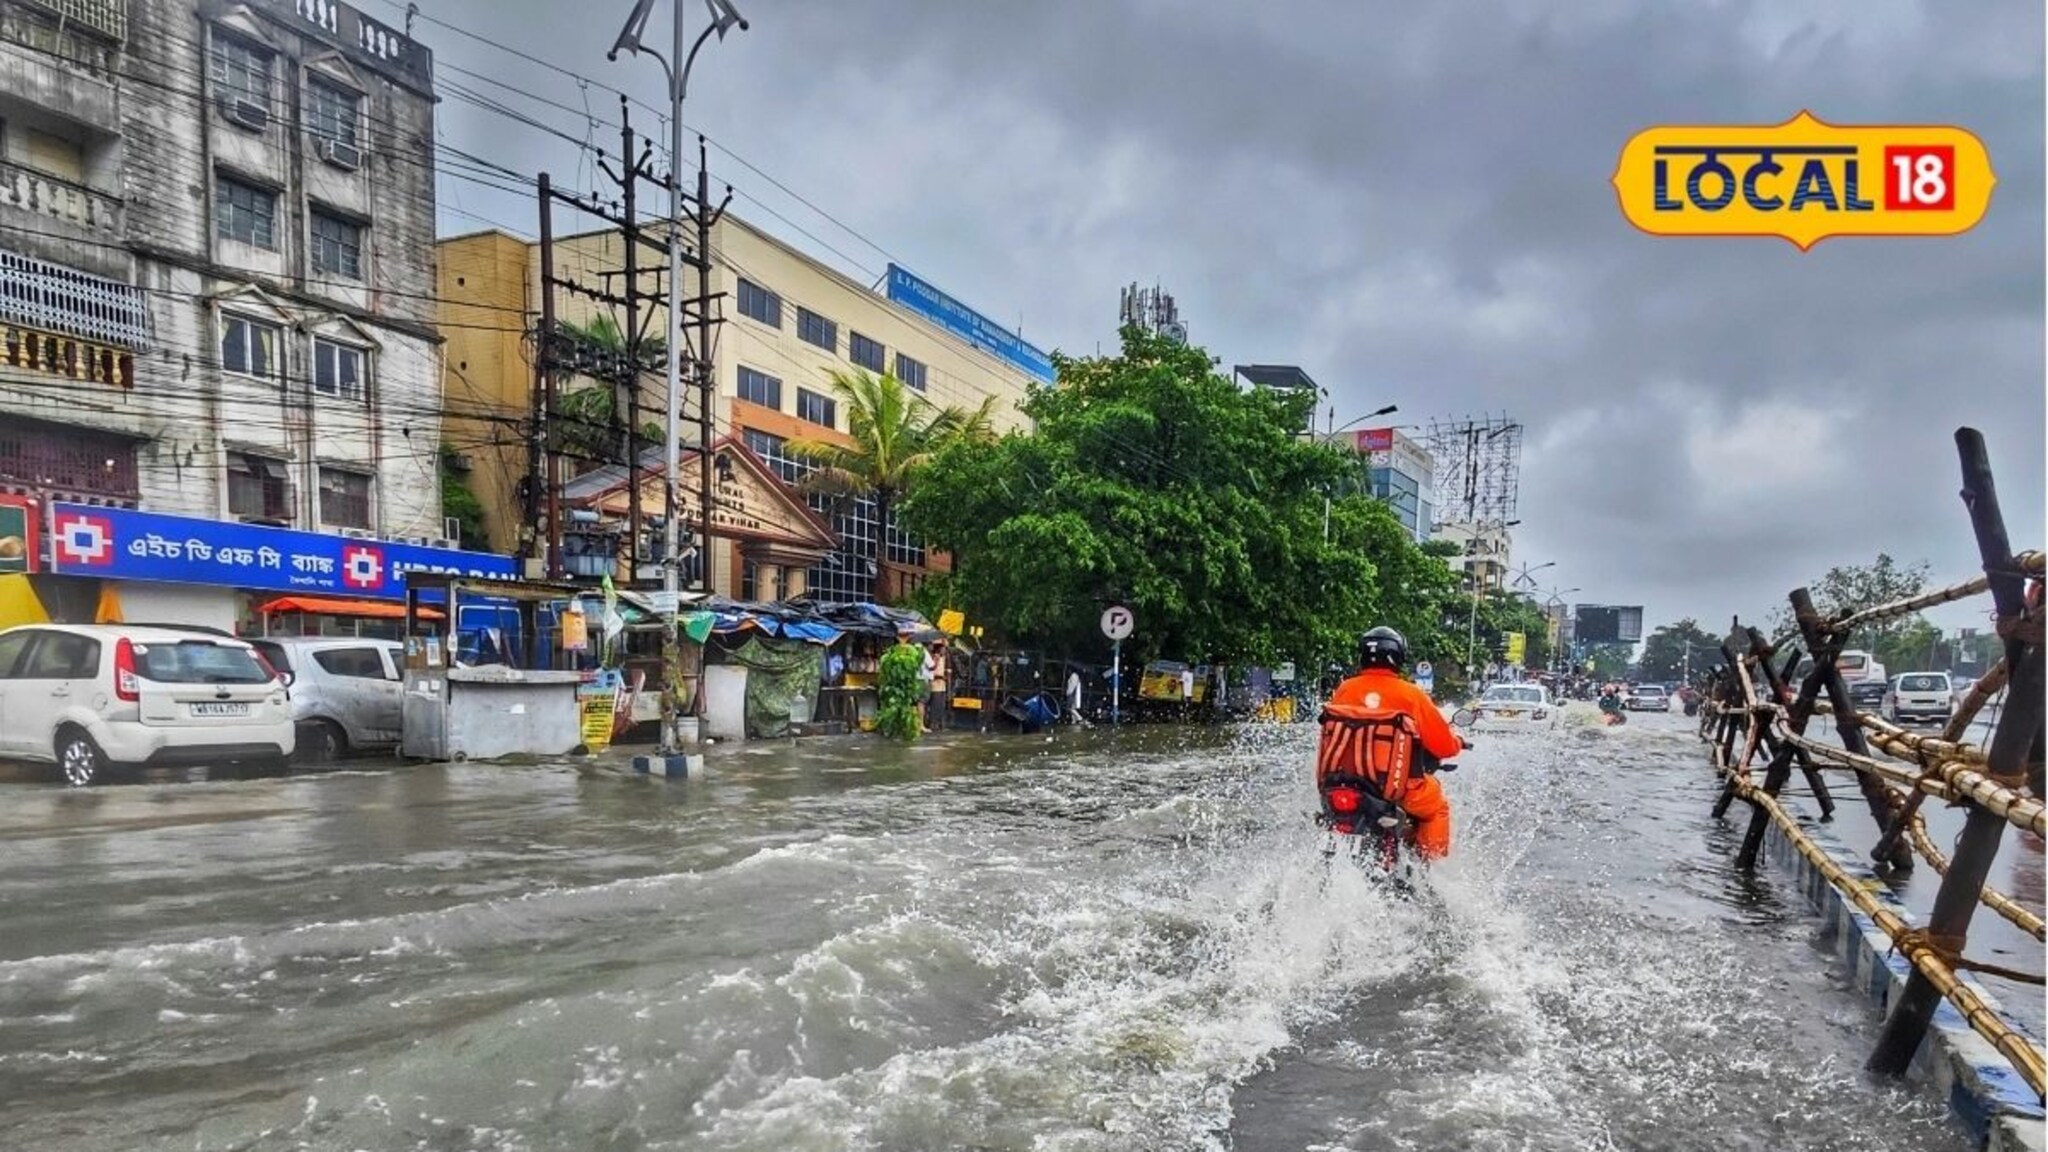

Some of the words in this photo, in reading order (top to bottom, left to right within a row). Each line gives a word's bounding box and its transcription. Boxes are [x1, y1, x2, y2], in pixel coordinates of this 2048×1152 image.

[128, 533, 182, 558] এইচ
[185, 538, 212, 561] ডি
[216, 547, 254, 566] এফ
[258, 546, 281, 569] সি
